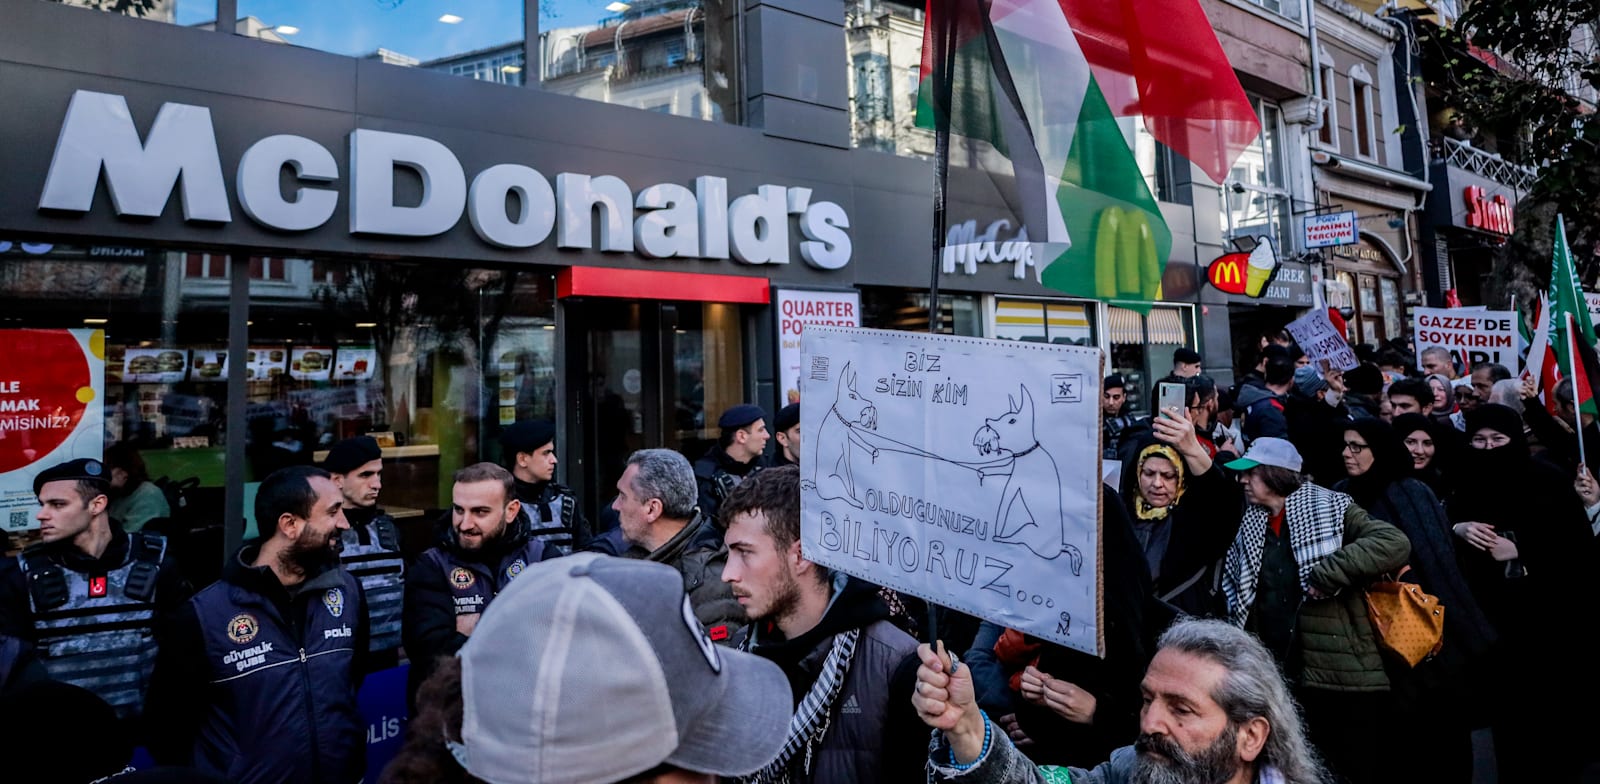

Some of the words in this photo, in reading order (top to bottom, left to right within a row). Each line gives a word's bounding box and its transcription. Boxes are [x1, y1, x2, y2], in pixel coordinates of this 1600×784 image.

[38, 89, 853, 270] McDonald's
[782, 299, 854, 318] QUARTER
[1419, 315, 1511, 331] GAZZE'DE
[1419, 330, 1512, 347] SOYKIRIM
[904, 347, 941, 372] BİZ
[875, 373, 922, 398] SİZİN
[931, 376, 968, 405] KİM
[453, 594, 484, 605] VENLİK
[324, 622, 352, 639] POLİS
[223, 641, 273, 665] GÜVENLİK
[236, 654, 266, 672] ŞUBE
[367, 715, 400, 744] LİS
